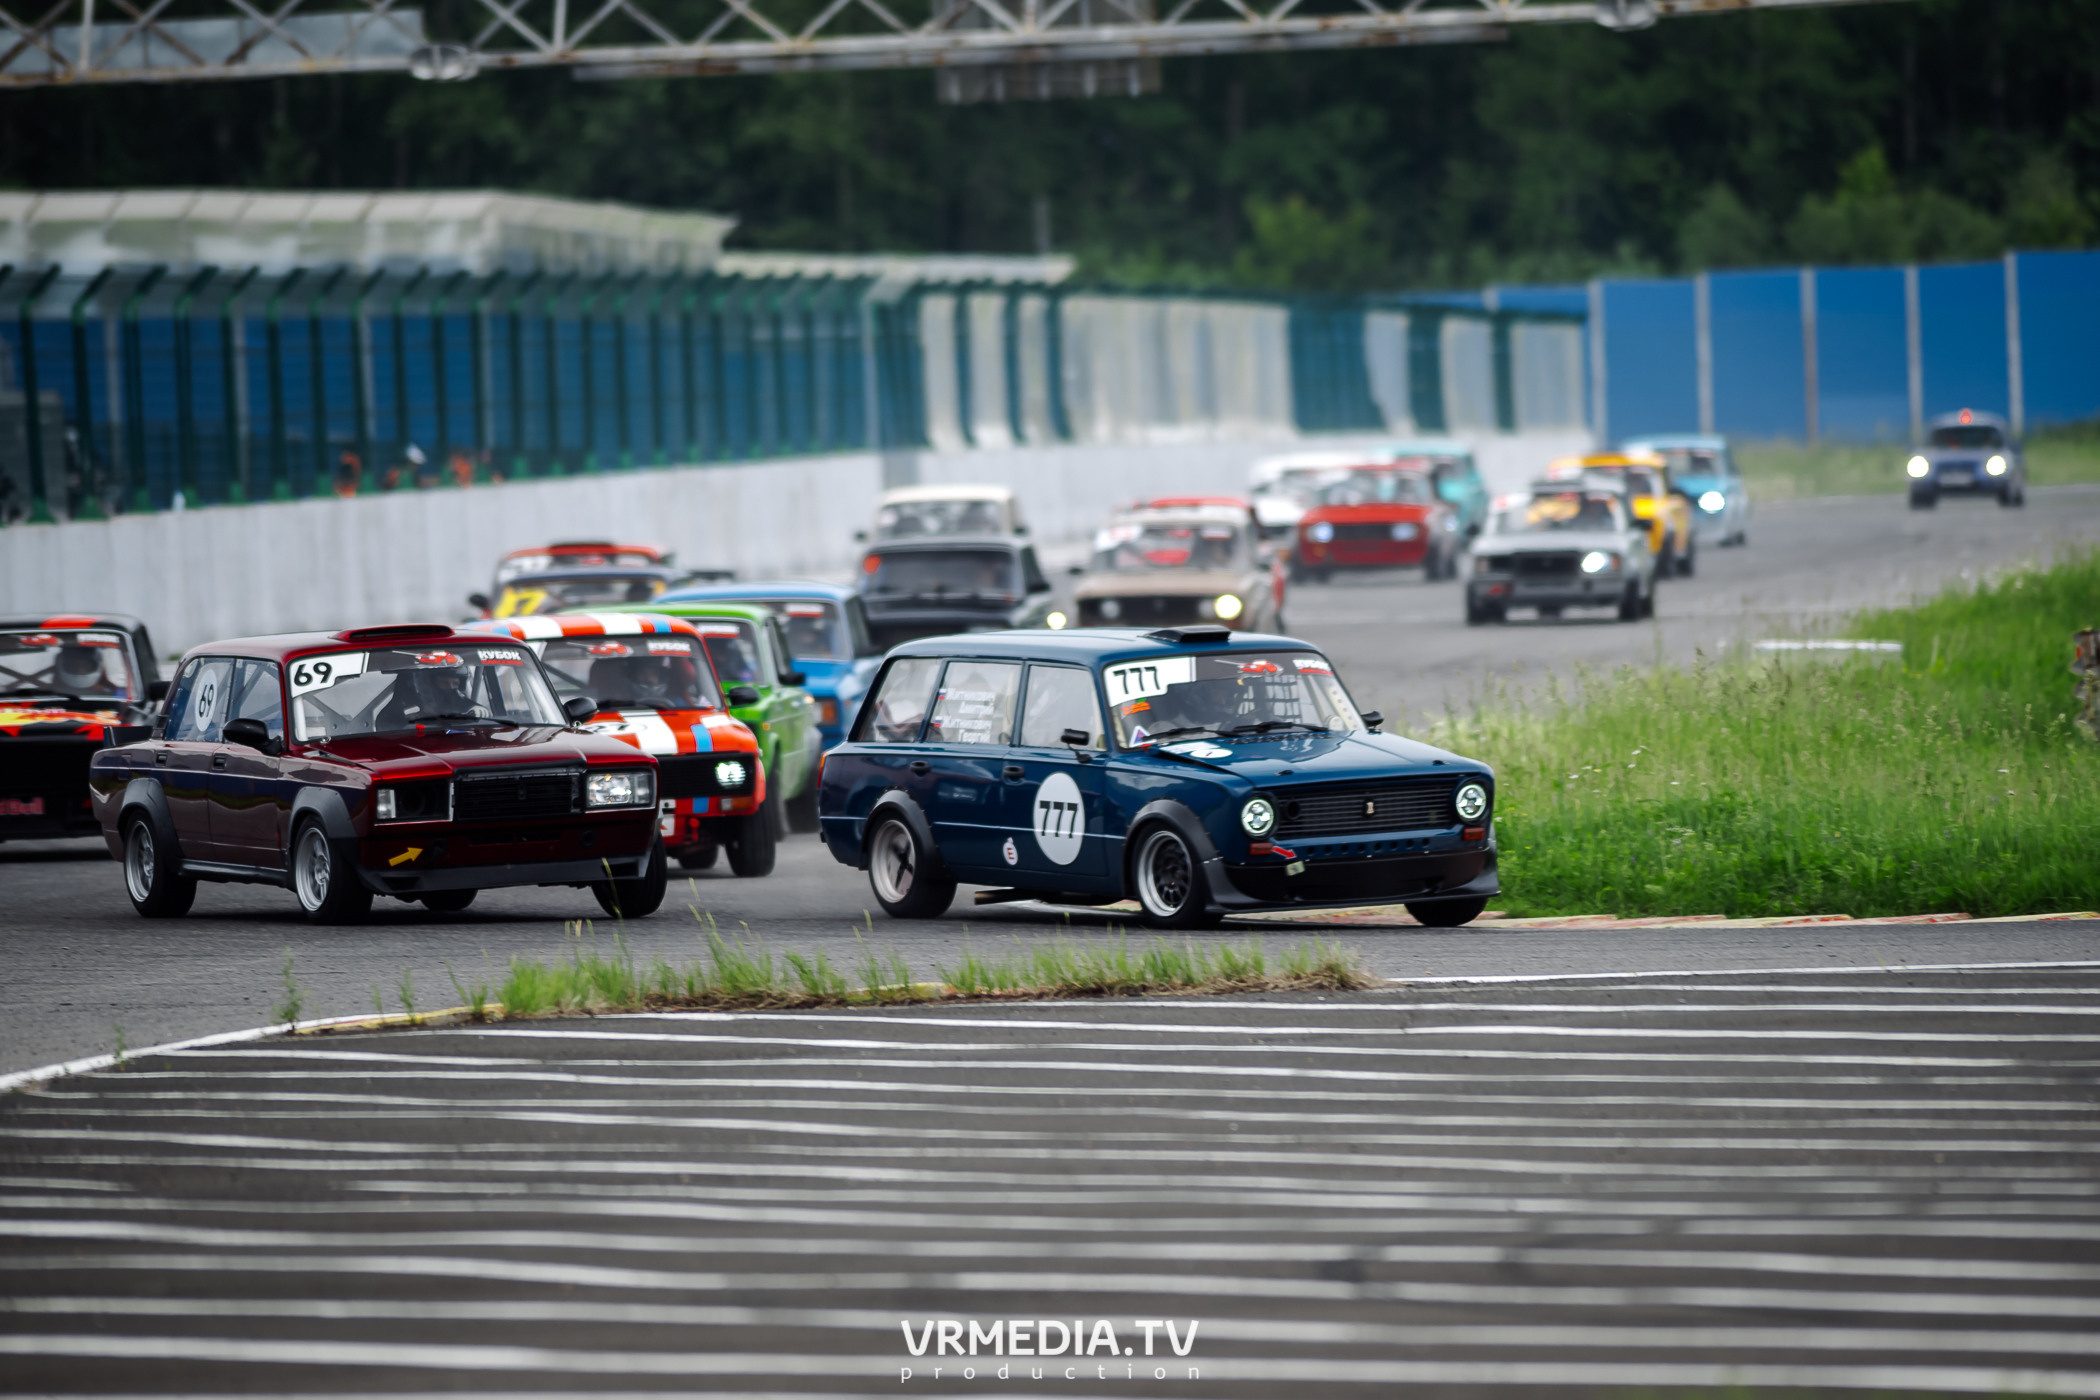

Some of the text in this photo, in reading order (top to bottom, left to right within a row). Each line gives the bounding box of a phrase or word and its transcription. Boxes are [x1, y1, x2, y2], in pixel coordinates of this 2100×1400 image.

[477, 649, 521, 660] КУБОК
[294, 662, 332, 687] 69
[1112, 666, 1160, 694] 777
[199, 684, 214, 718] 69
[1040, 800, 1078, 838] 777
